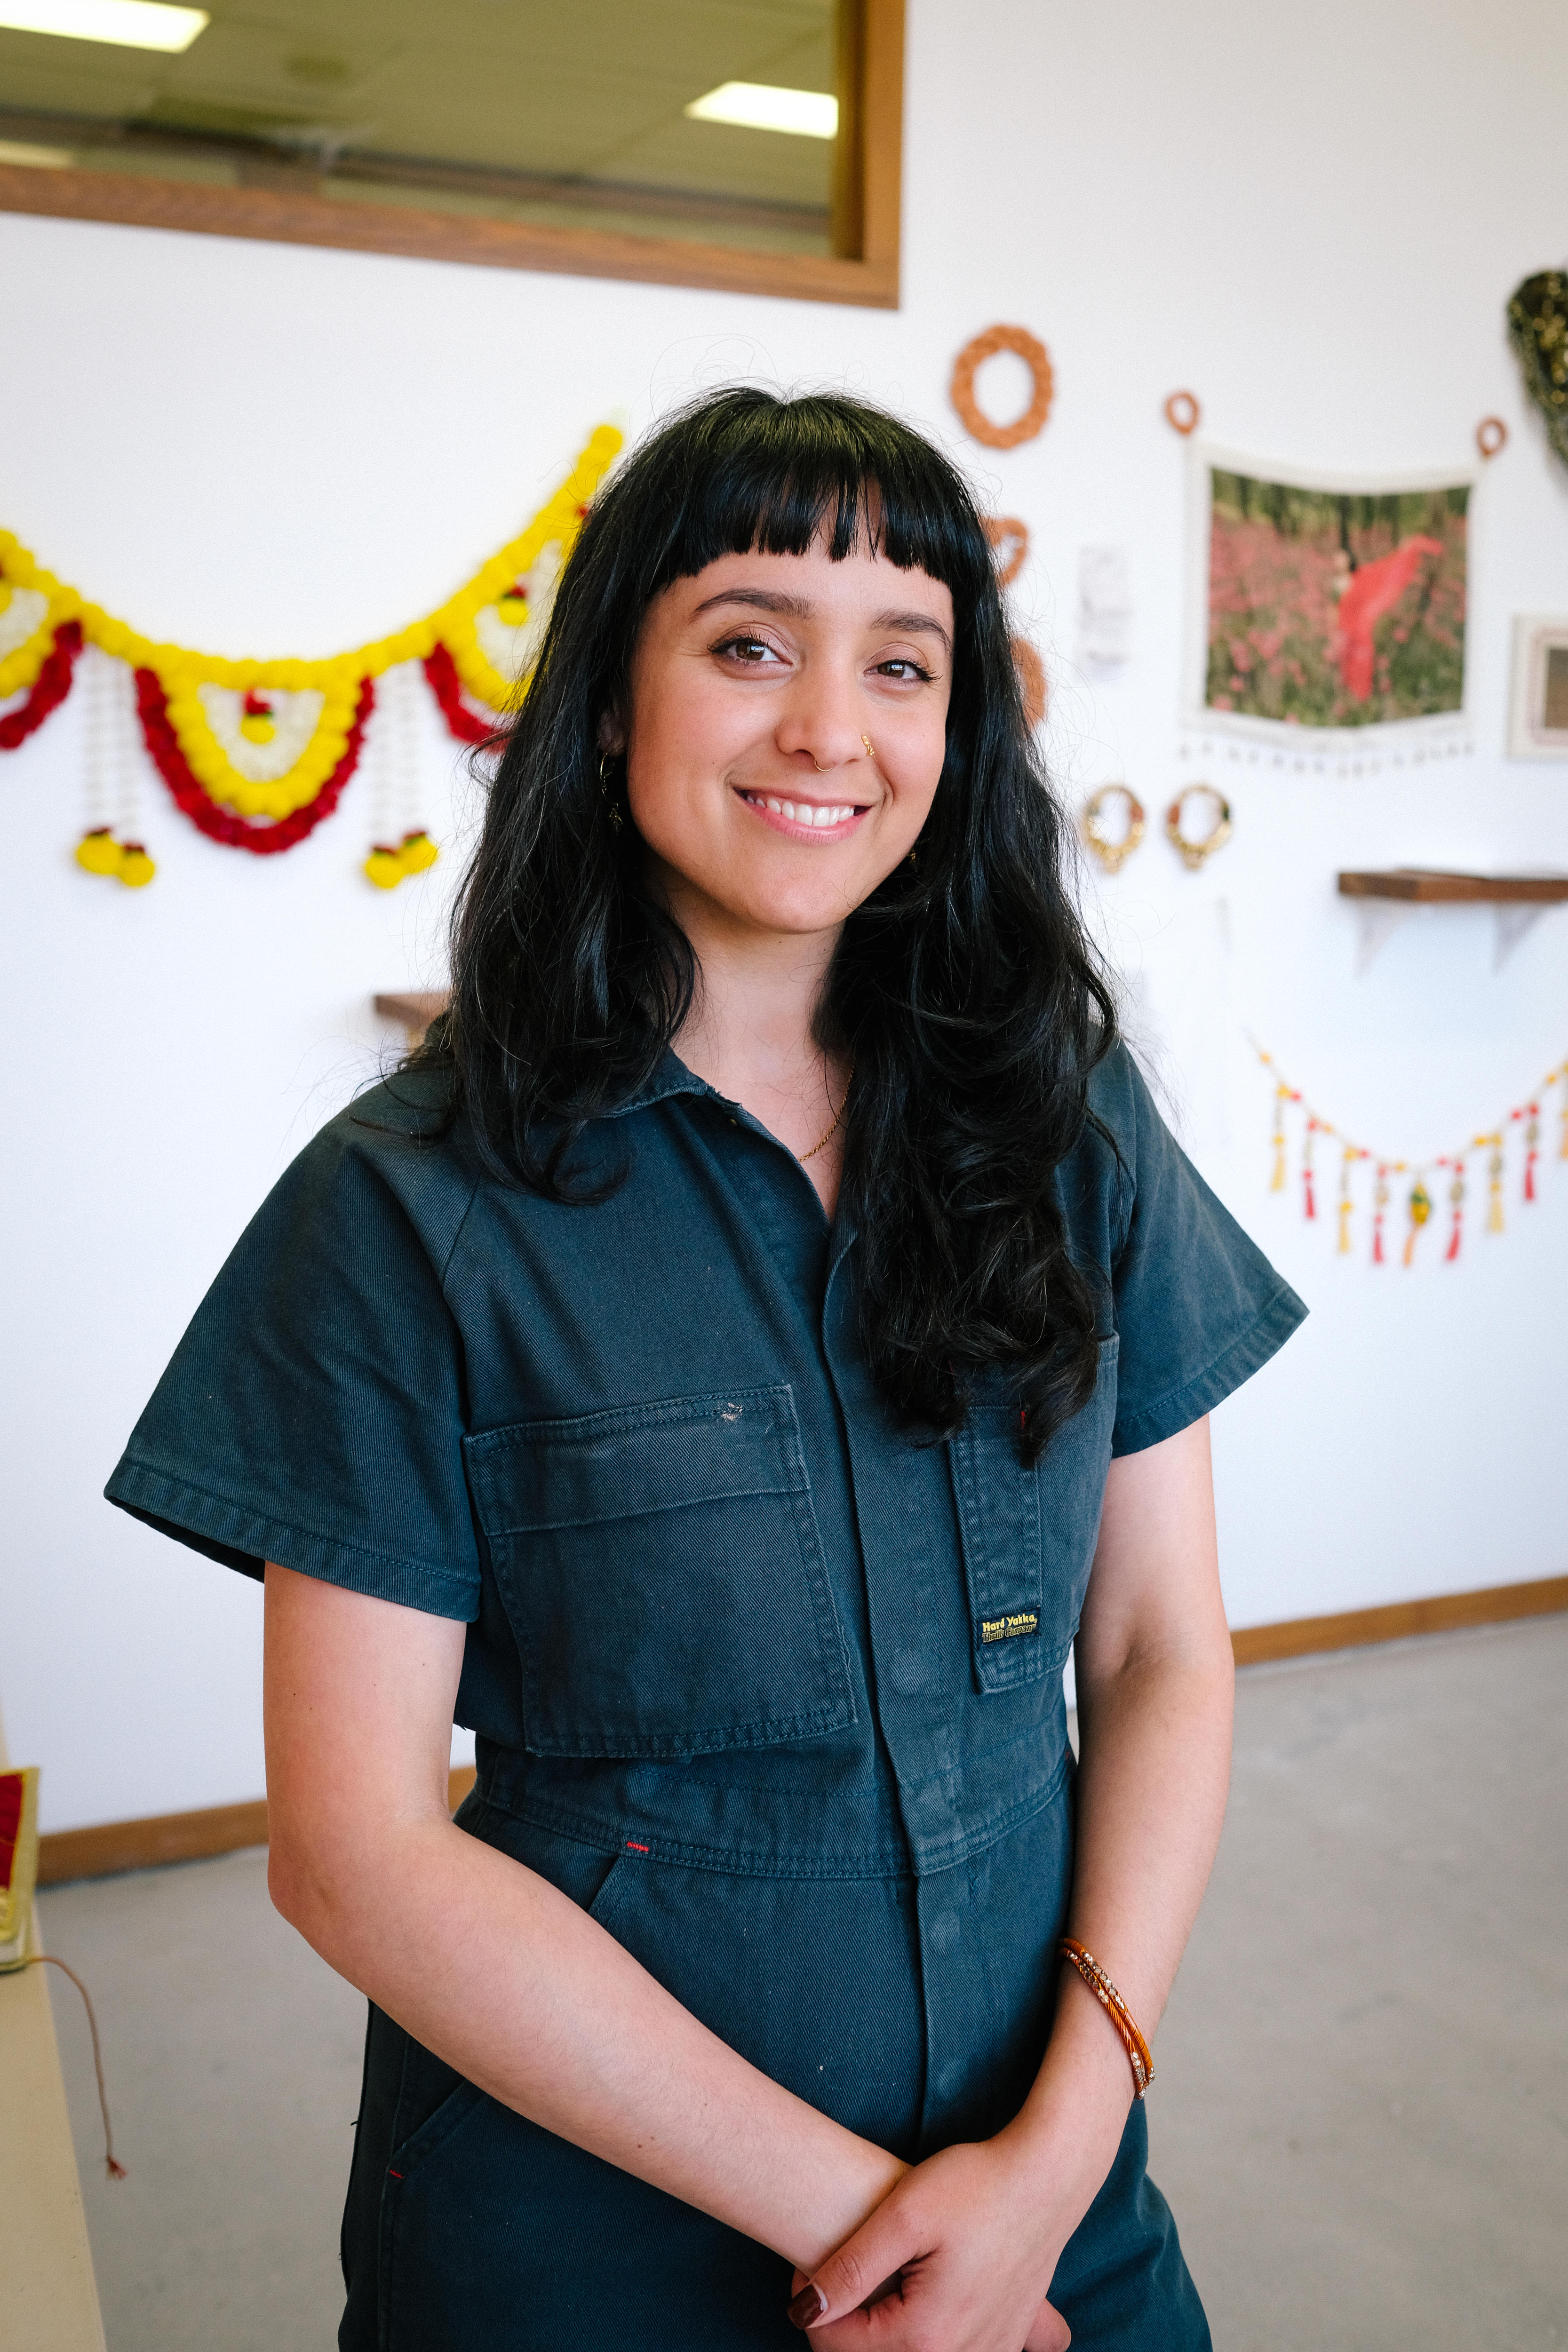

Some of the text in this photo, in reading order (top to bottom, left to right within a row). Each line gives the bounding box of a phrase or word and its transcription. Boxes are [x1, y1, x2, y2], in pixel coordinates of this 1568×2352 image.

[982, 1613, 1035, 1632] Hard Yakka
[982, 1623, 1036, 1643] Thrills Company
